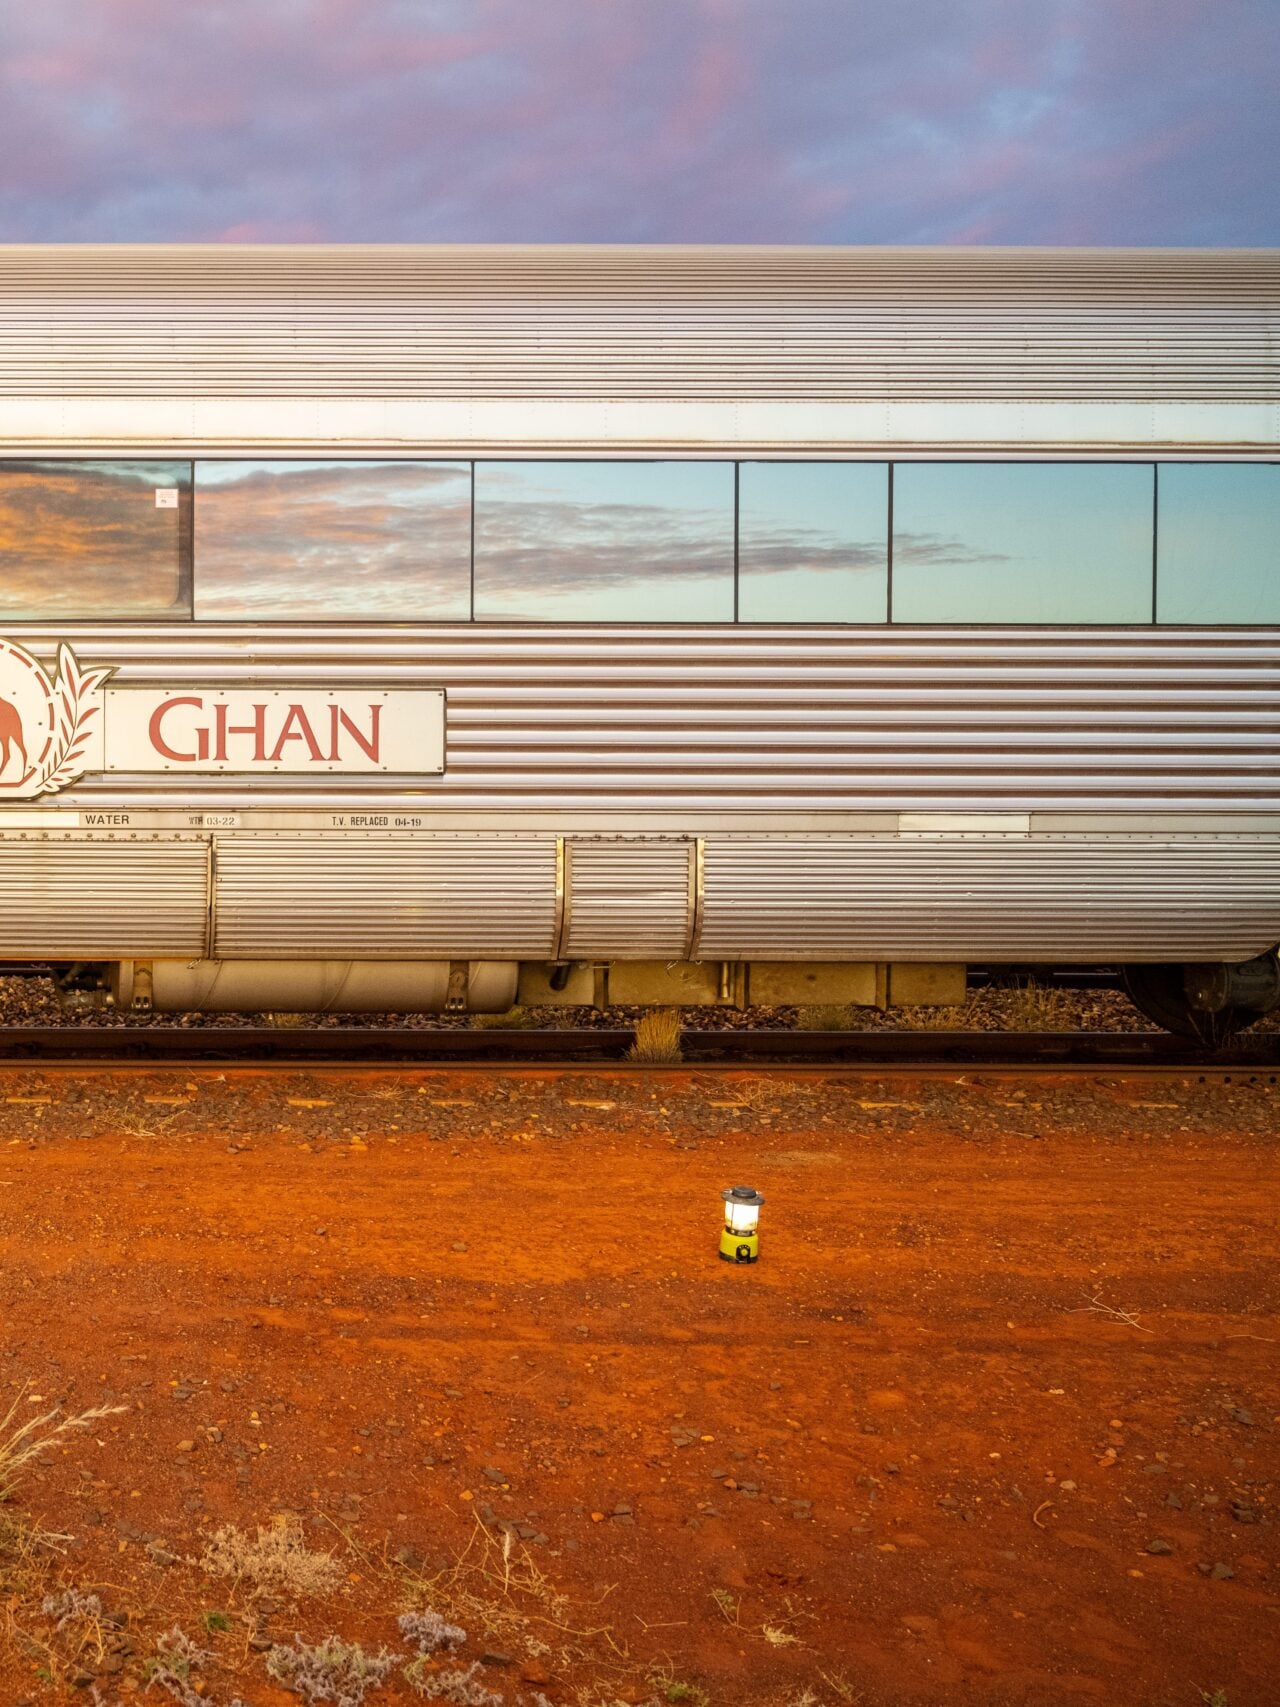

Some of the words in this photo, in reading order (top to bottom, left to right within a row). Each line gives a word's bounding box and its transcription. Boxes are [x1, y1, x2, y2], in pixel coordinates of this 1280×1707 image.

[148, 696, 384, 764] GHAN
[85, 814, 130, 825] WATER
[206, 816, 235, 826] 03-22
[332, 816, 347, 826] T.V.
[350, 816, 389, 826] REPLACED
[395, 817, 422, 827] 04-19
